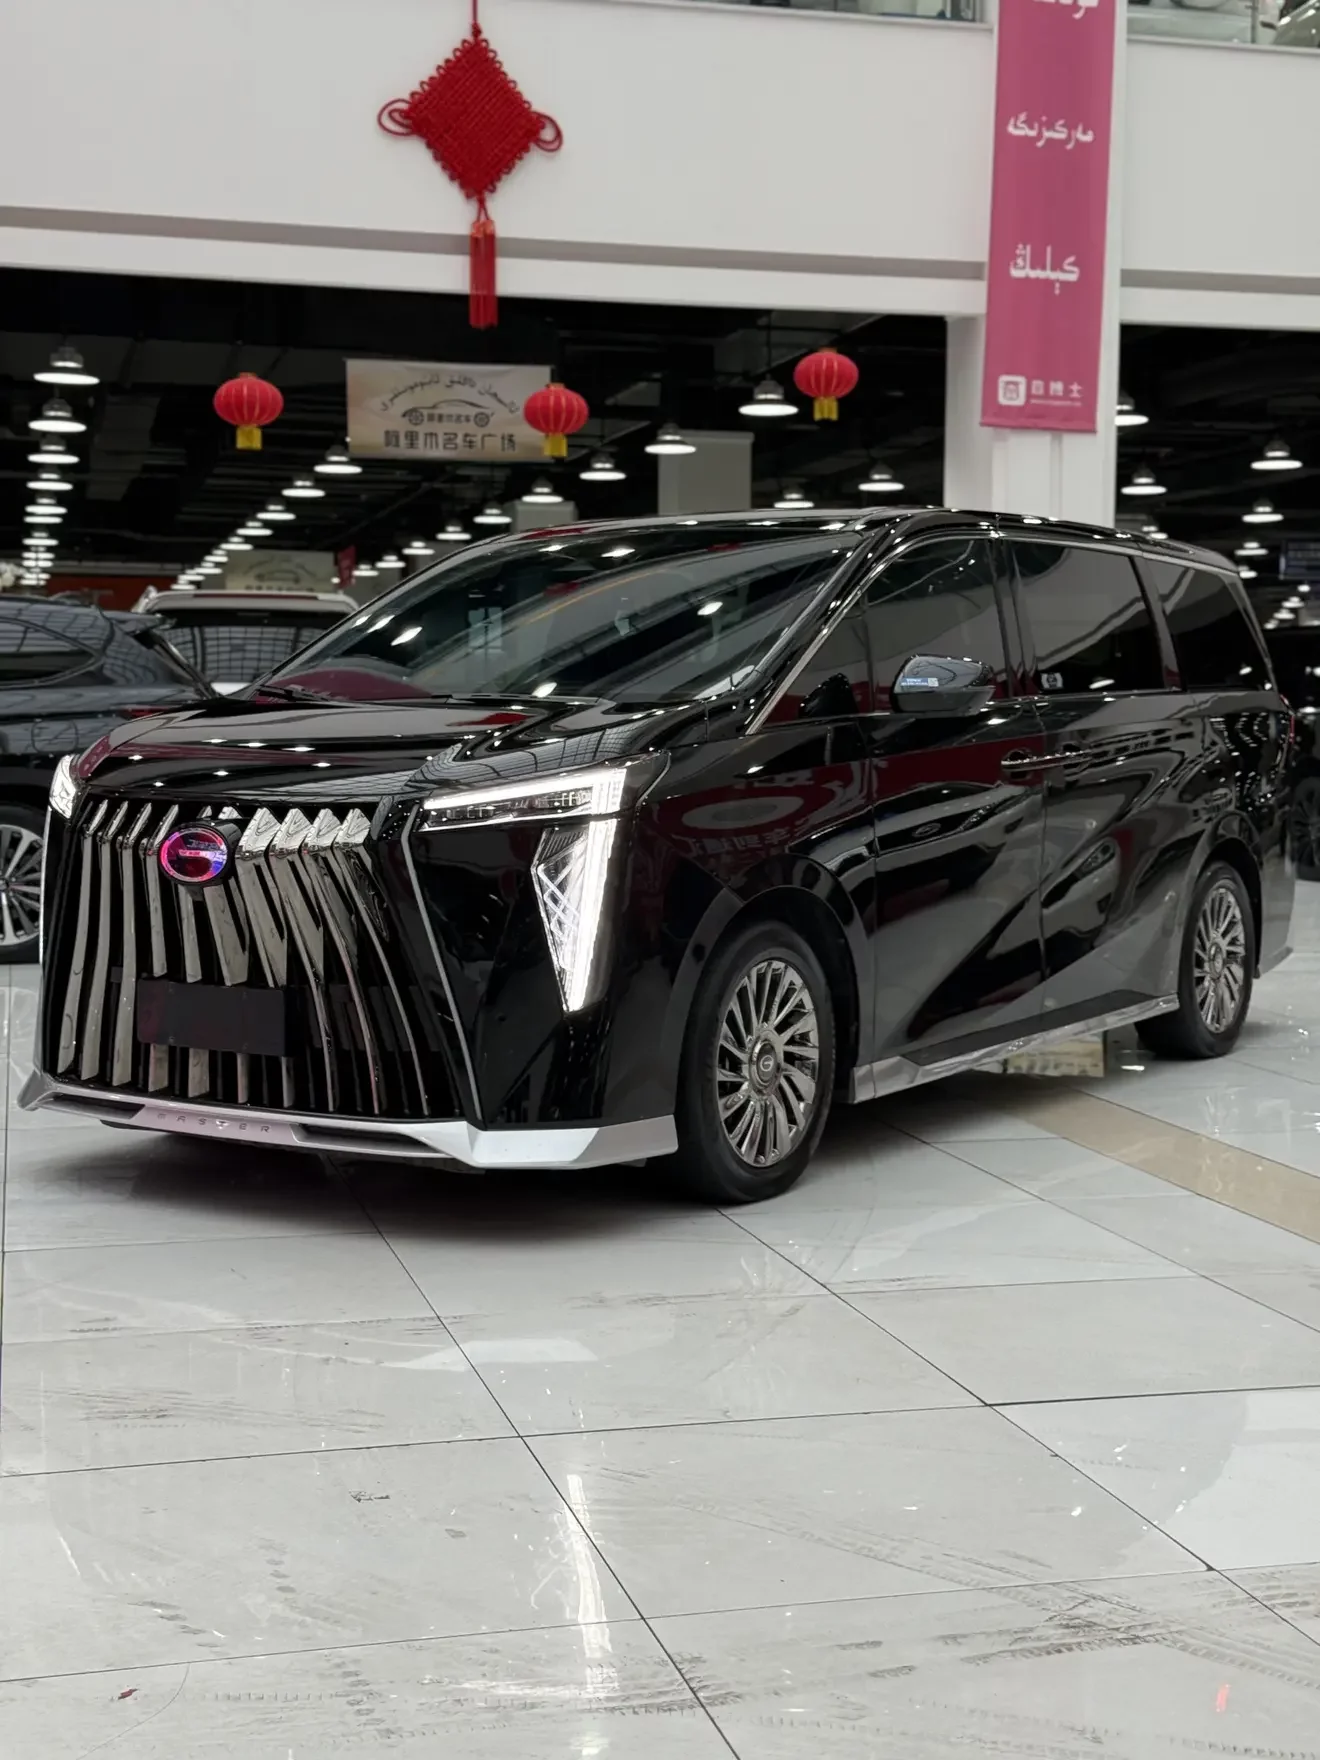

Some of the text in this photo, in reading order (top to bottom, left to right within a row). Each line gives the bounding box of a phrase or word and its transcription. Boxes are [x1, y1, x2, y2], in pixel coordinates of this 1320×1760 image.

[384, 429, 517, 452] 阿里木名车广场
